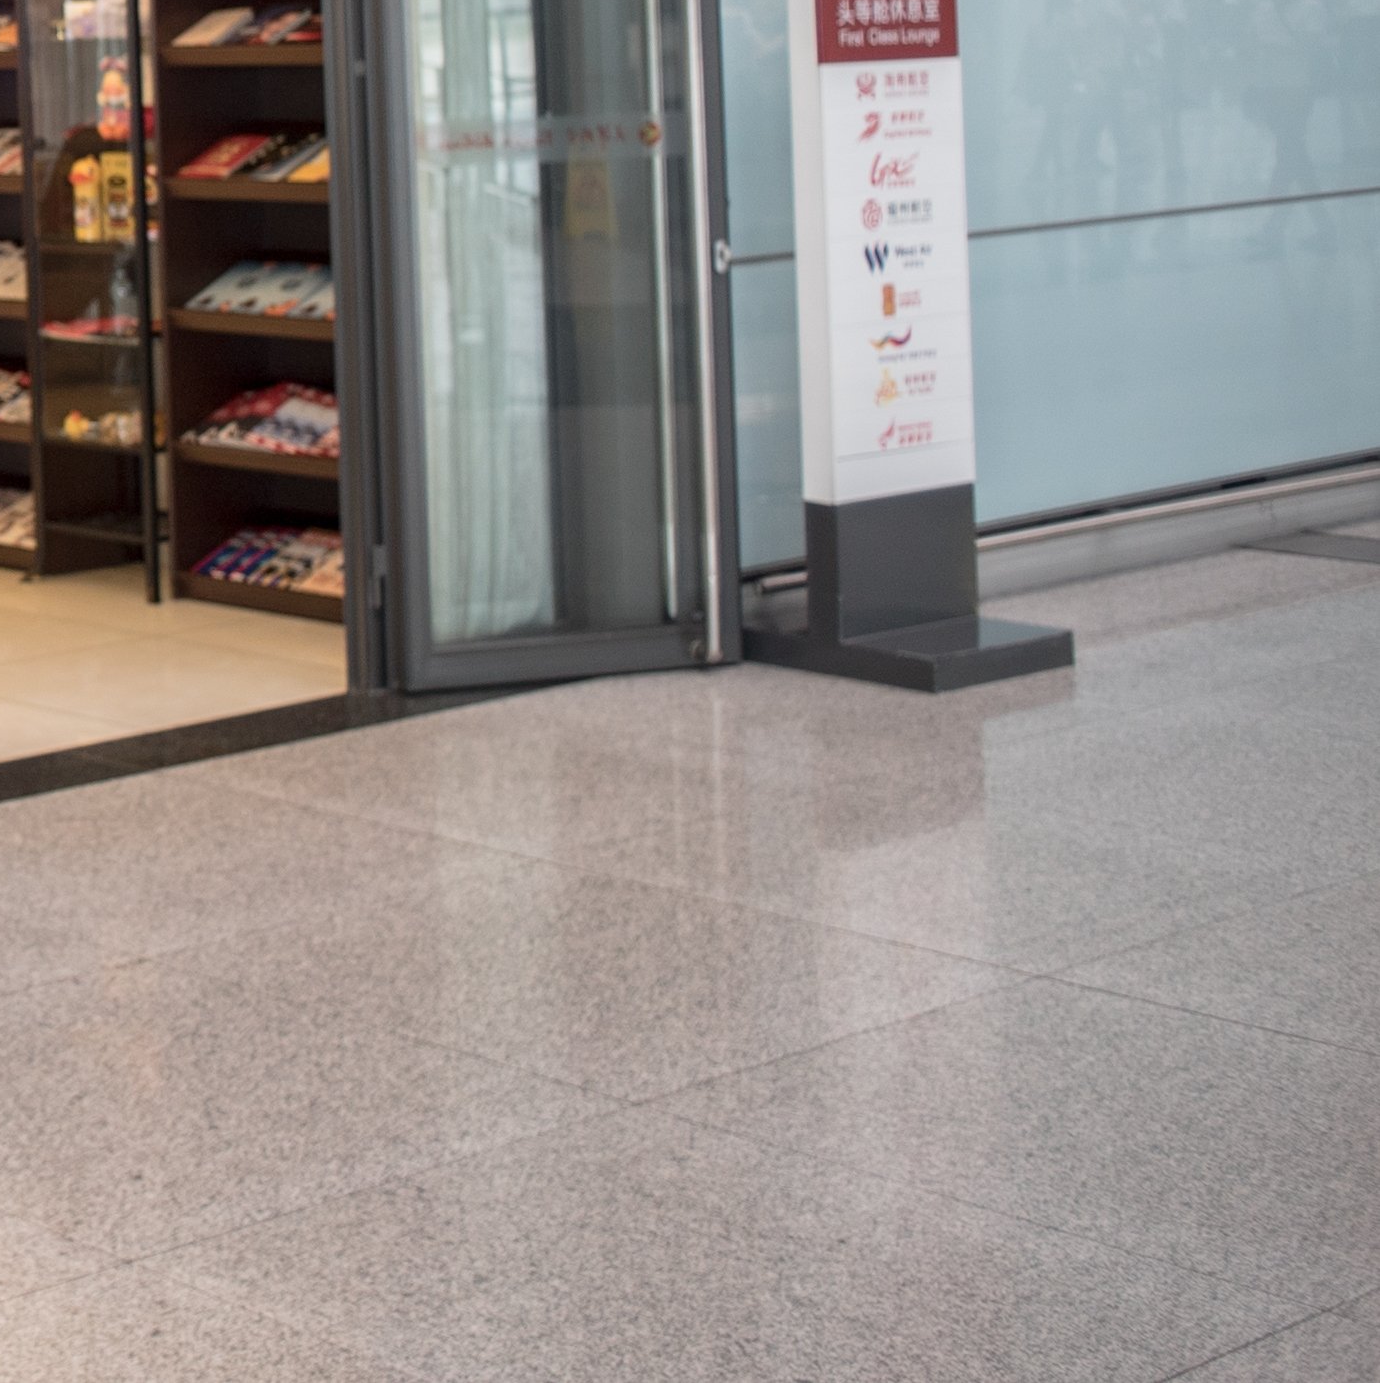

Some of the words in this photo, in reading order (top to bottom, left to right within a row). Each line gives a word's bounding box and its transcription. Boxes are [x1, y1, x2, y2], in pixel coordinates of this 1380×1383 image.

[839, 28, 864, 48] First
[868, 27, 899, 46] Class
[902, 27, 940, 48] Lounge
